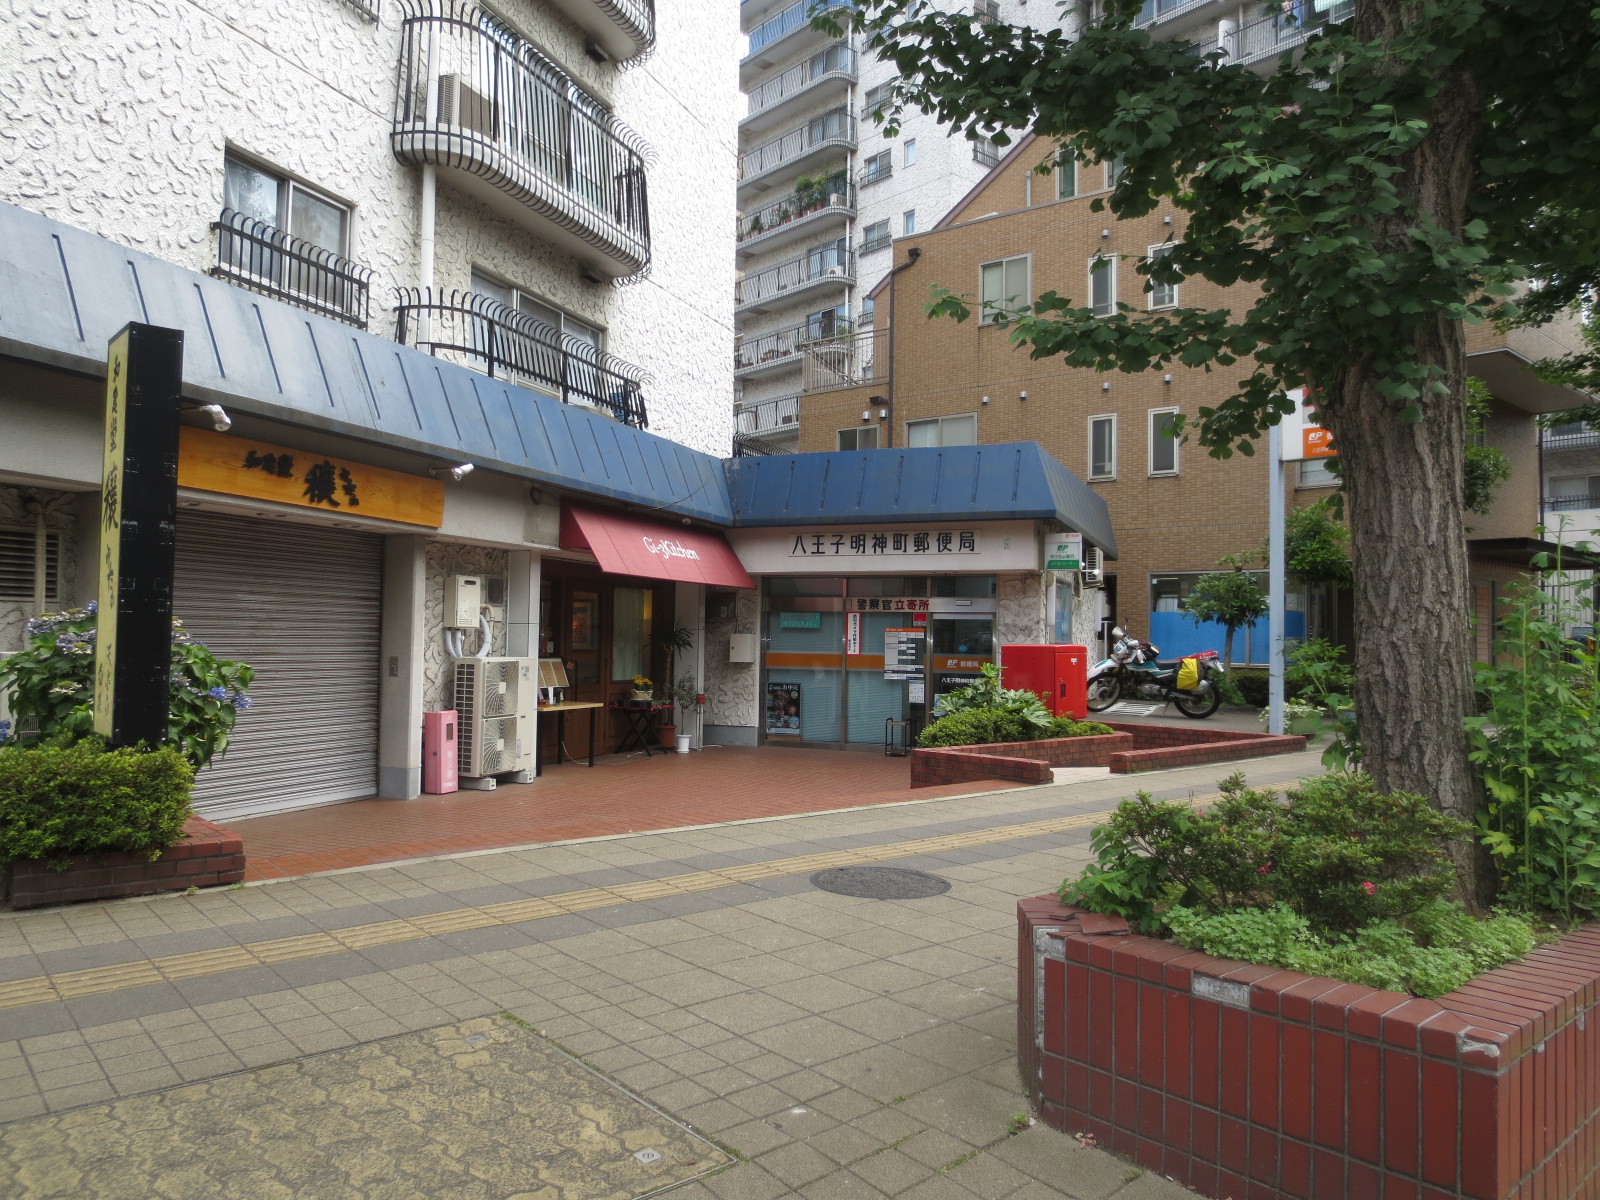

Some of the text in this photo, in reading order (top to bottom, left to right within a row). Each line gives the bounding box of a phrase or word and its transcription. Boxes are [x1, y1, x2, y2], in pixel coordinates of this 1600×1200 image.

[792, 531, 975, 555] 八王子明神町郵便局
[857, 599, 929, 611] 警察官立寄所
